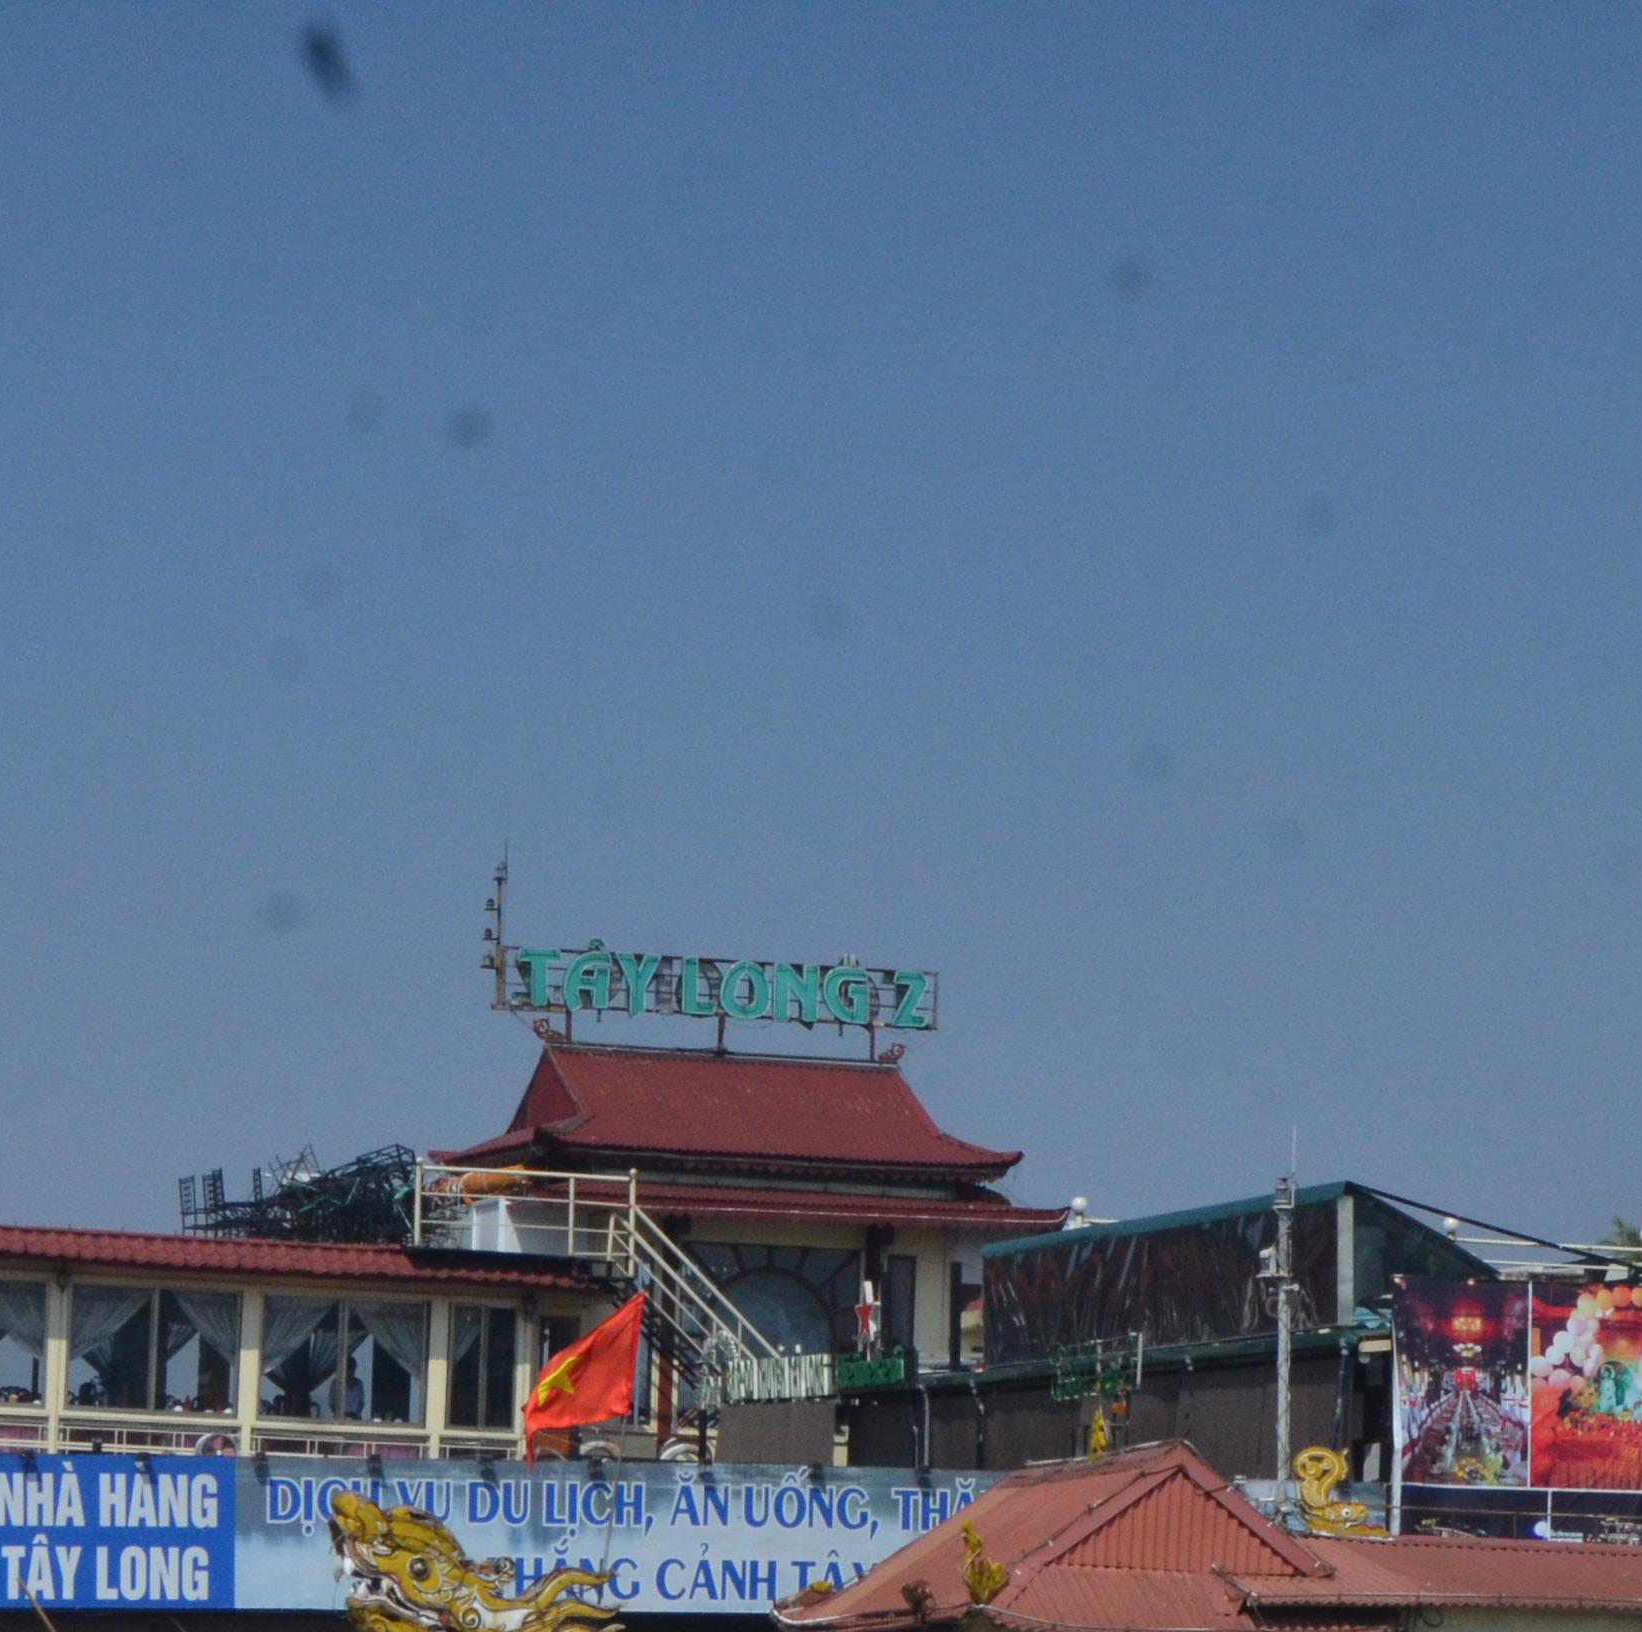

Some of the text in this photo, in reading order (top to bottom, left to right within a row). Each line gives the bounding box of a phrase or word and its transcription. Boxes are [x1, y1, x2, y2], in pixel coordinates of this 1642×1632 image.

[518, 938, 662, 1018] TÂY
[681, 957, 870, 1025] LONG
[466, 1479, 531, 1526] DU
[669, 1470, 732, 1528] ĂN
[891, 1478, 986, 1534] THĂ
[1, 1534, 82, 1600] TÂY
[96, 1545, 209, 1601] LONG
[656, 1542, 778, 1602] CẢNH
